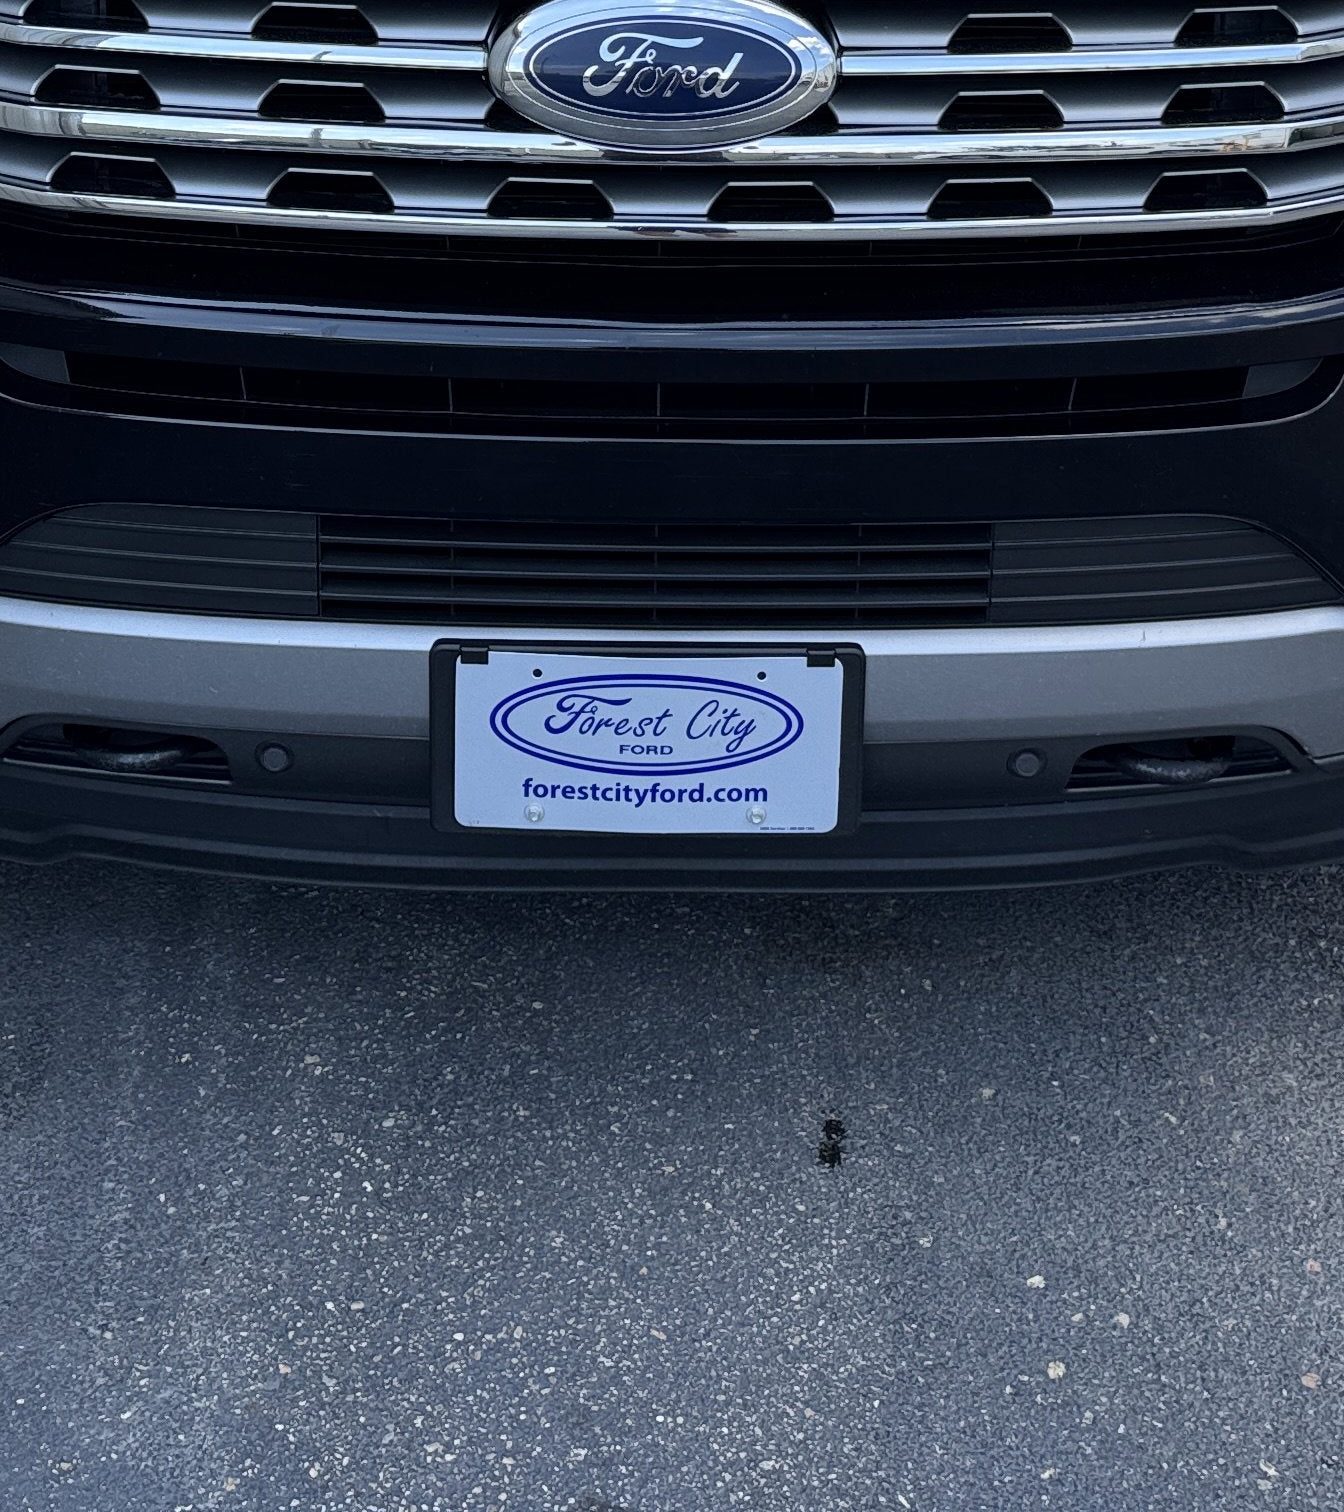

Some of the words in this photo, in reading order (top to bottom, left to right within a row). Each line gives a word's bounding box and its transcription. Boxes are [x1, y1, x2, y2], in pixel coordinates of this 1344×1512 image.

[583, 32, 743, 98] Ford
[544, 694, 673, 737] Forest
[686, 699, 757, 754] City
[619, 744, 673, 756] FORD
[522, 778, 768, 808] forestcityford.com
